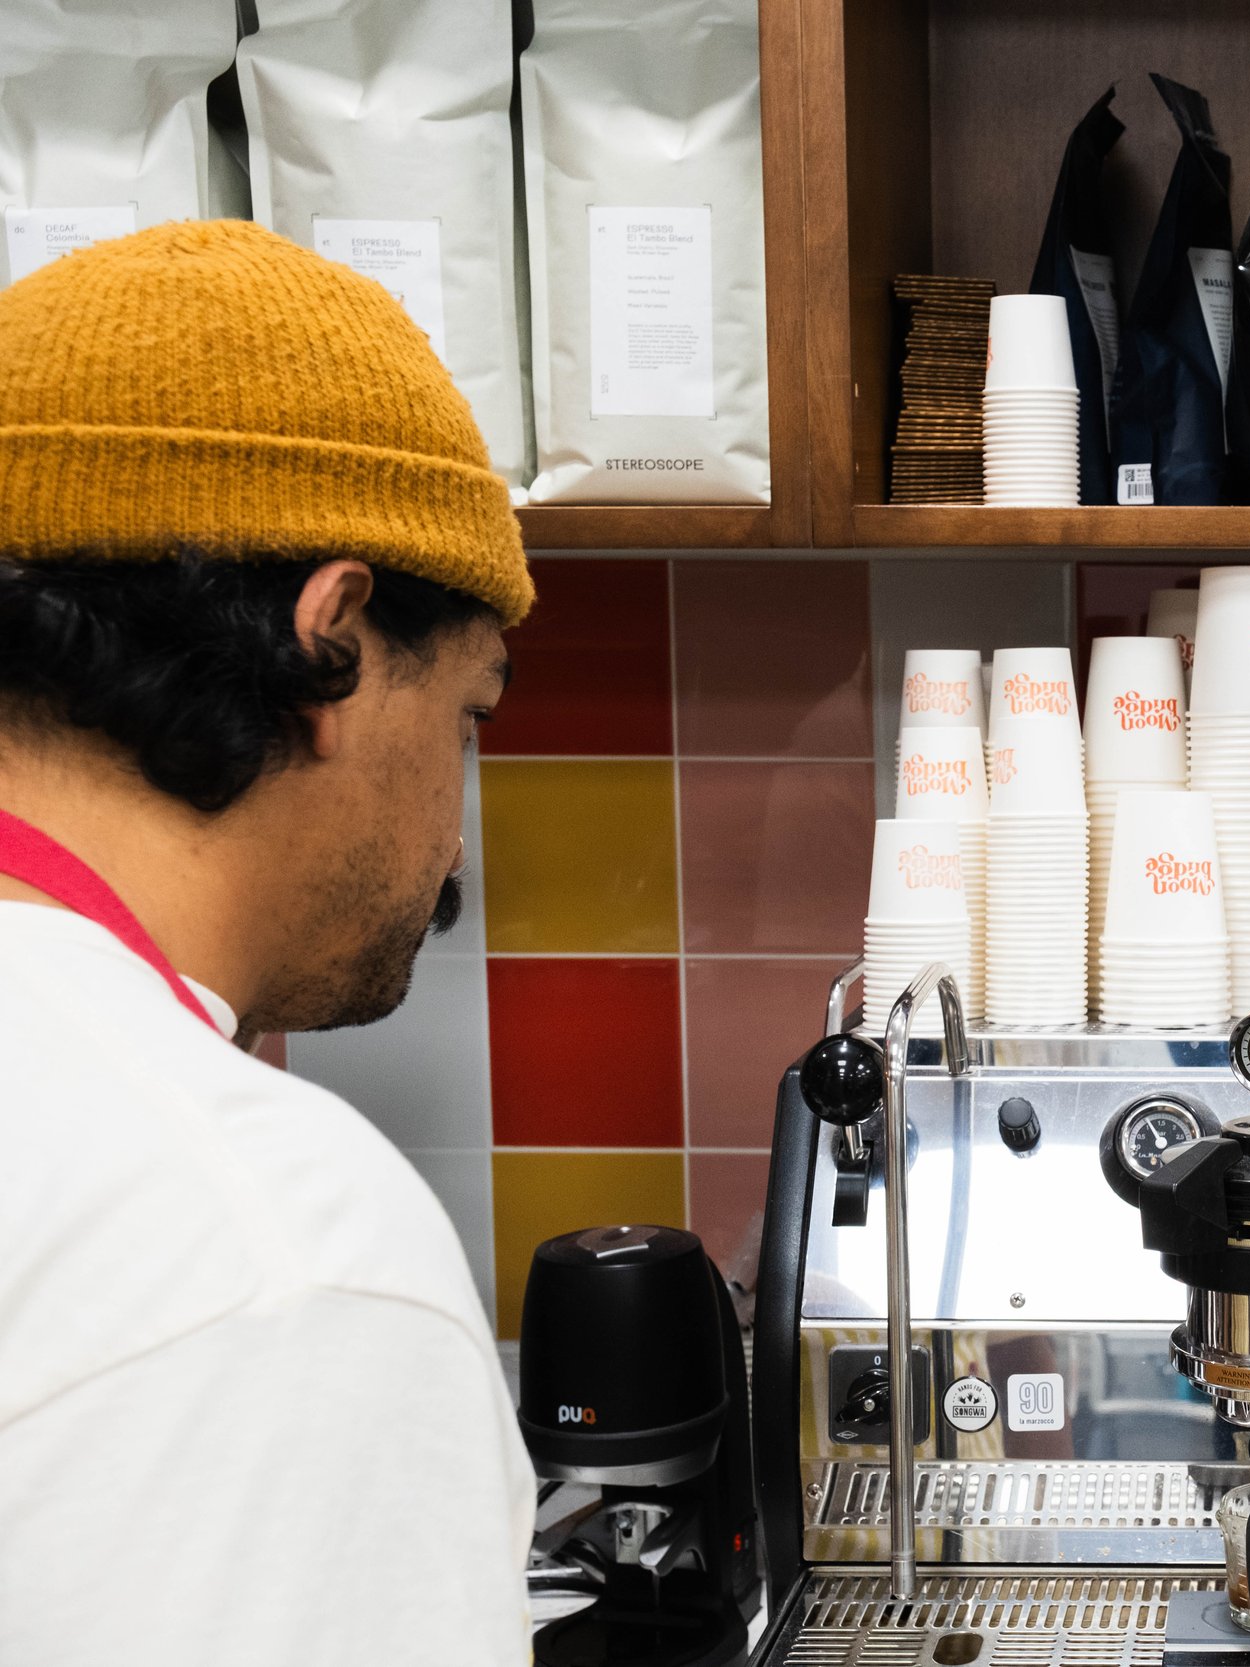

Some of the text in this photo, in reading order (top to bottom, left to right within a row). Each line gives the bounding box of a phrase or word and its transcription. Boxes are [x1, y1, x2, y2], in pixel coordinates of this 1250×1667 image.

[45, 224, 76, 233] DECAF
[627, 224, 674, 234] ESPRESSO
[668, 234, 694, 243] Blend
[352, 238, 401, 247] ESPRESSO
[396, 248, 422, 256] Blend
[606, 458, 704, 470] STEREOSCOPE
[906, 672, 968, 699] bridge
[1004, 673, 1068, 699] bridge
[906, 692, 972, 716] Moon
[1004, 694, 1072, 715] Moon
[1114, 690, 1178, 716] bridge
[1114, 710, 1182, 732] Moon
[903, 754, 968, 780] bridge
[903, 775, 972, 796] Moon
[1145, 852, 1211, 880] bridge
[1145, 872, 1215, 896] Moon
[958, 1384, 982, 1392] HANDS FOR
[1019, 1382, 1054, 1414] 90
[954, 1407, 985, 1416] SONGWA
